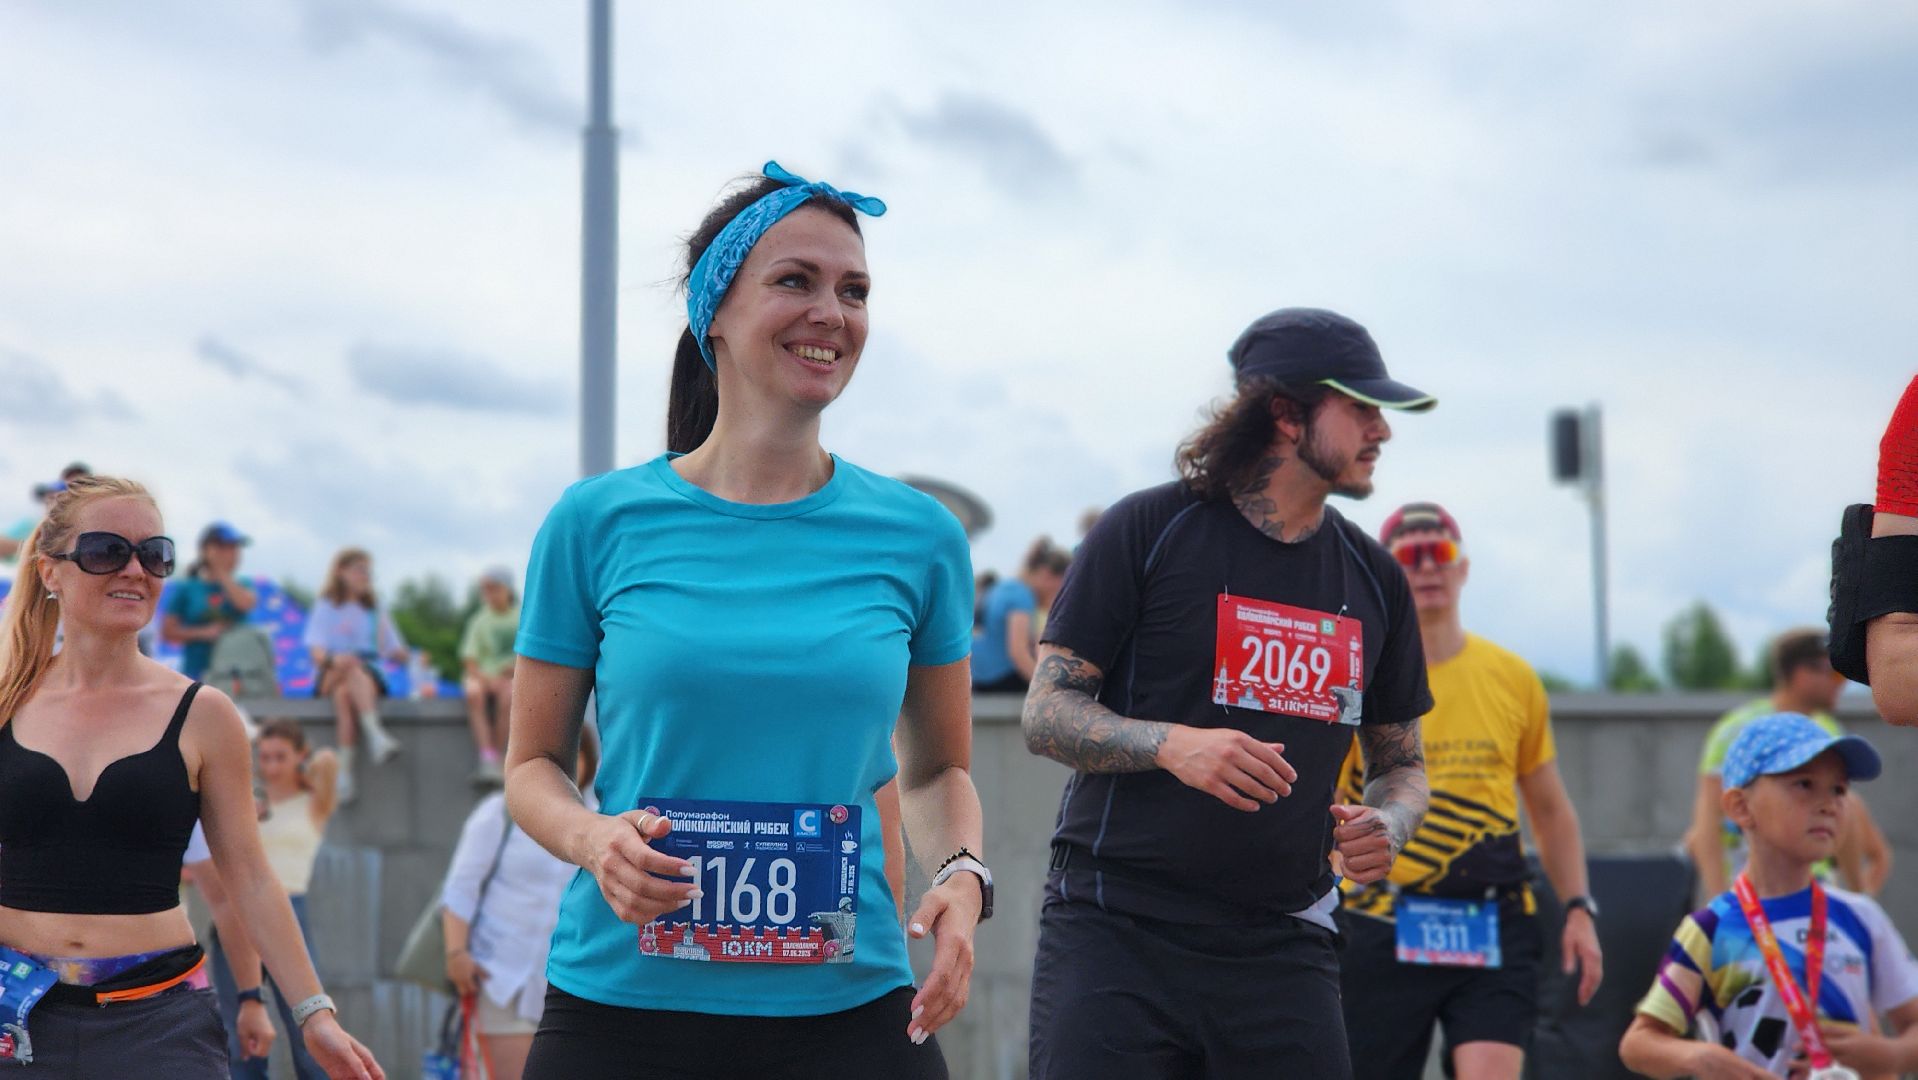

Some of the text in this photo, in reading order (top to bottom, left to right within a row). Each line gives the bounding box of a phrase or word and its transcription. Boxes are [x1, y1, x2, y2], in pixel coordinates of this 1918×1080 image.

[1240, 635, 1331, 693] 2069
[665, 809, 730, 821] Полумарафон
[671, 819, 790, 835] ОЛОКОЛАМСКИЙ РУБЕЖ
[686, 855, 797, 925] 1168
[1420, 921, 1470, 951] 1311
